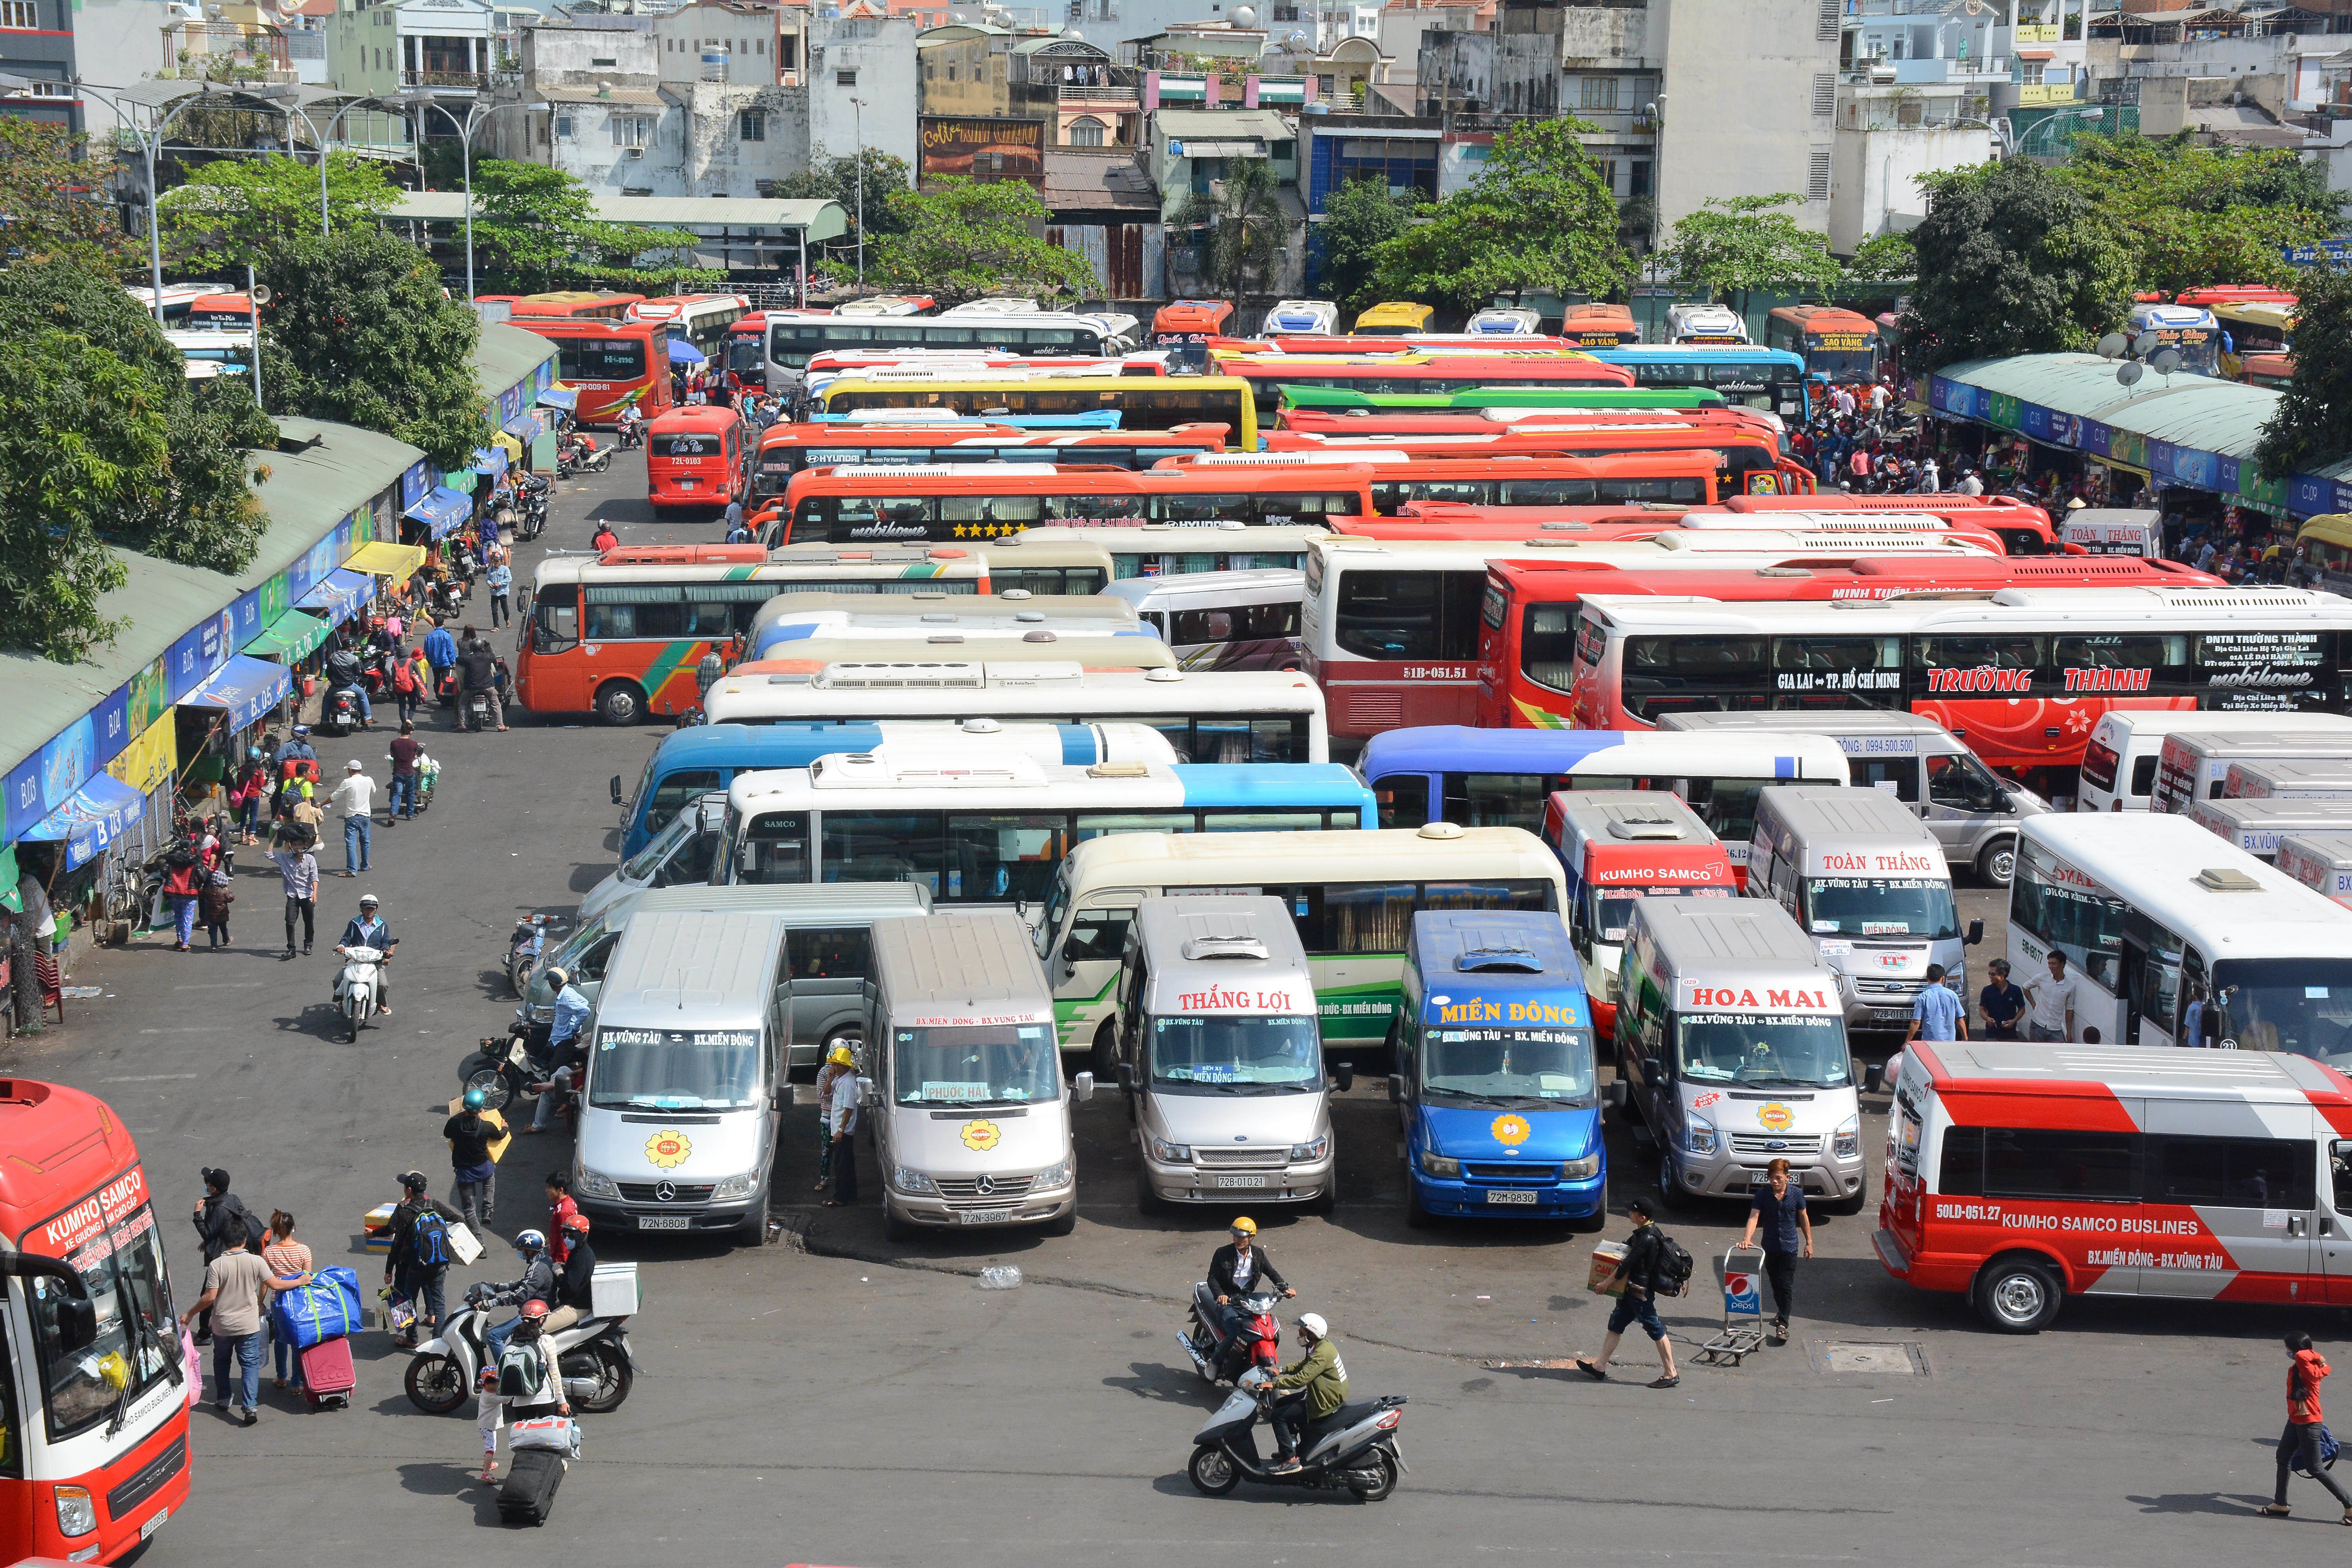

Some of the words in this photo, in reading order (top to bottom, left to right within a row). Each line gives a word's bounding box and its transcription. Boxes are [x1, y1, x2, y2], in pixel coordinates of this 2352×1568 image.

[924, 122, 960, 148] Coffee
[1158, 334, 1183, 345] Quốc
[1598, 337, 1619, 346] VÀNG
[1841, 337, 1862, 347] VÀNG
[1715, 381, 1766, 392] mobihome
[819, 455, 860, 463] HYUNDAI
[2223, 464, 2236, 481] C.10
[2302, 484, 2317, 501] C.09
[1116, 515, 1130, 528] MIỀN
[1266, 515, 1292, 523] New
[851, 521, 927, 538] mobihome
[2071, 526, 2097, 540] TOÀN
[2107, 525, 2141, 541] THẮNG
[2116, 545, 2127, 554] MIỀN
[1832, 588, 1870, 598] MINH
[245, 601, 255, 625] B.06
[2236, 632, 2279, 644] TRƯỜNG
[2281, 632, 2317, 643] THÀNH
[183, 648, 193, 674] B.05
[1778, 672, 1795, 690] GIA
[1797, 672, 1813, 690] LAI
[1827, 672, 1840, 689] TP.
[1842, 667, 1855, 689] HỒ
[1858, 668, 1874, 689] CHÍ
[1875, 672, 1900, 689] MINH
[1927, 665, 2034, 691] TRƯỜNG
[2064, 664, 2151, 691] THÀNH
[2209, 665, 2314, 686] mobihome
[251, 696, 260, 718] B.
[261, 686, 272, 710] 05
[108, 708, 121, 739] B.04
[1866, 739, 1913, 753] 0994.500.500
[21, 775, 36, 809] B.03
[109, 809, 122, 837] 03
[1823, 853, 1866, 869] TOÀN
[1876, 851, 1931, 870] THẮNG
[1600, 869, 1654, 881] KUMHO
[1658, 868, 1711, 880] SAMCO
[1649, 886, 1664, 895] HÀNG
[1815, 878, 1850, 888] BX.VŨNG
[1851, 878, 1868, 888] TÀU
[1889, 878, 1922, 889] BX.MIỀN
[1924, 878, 1946, 889] ĐÔNG
[1864, 923, 1884, 935] MIỀN
[1178, 984, 1250, 1011] THẮNG
[1257, 990, 1291, 1013] LỢI
[1691, 988, 1759, 1007] HOA
[1767, 989, 1828, 1008] MAI
[1353, 1001, 1370, 1014] MIỀN
[1372, 1002, 1392, 1014] ĐÔNG
[1440, 996, 1501, 1024] MIỀN
[1509, 1000, 1577, 1024] ĐÔNG
[916, 1015, 948, 1025] BX.MIỀN
[952, 1016, 974, 1025] ĐÔNG
[982, 1014, 1016, 1025] BX.VŨNG
[1018, 1013, 1035, 1022] TÀU
[1268, 1017, 1290, 1025] BX.MIỀN
[1691, 1014, 1734, 1025] BX.VŨNG
[1735, 1014, 1756, 1025] TÀU
[1766, 1015, 1804, 1026] BX.MIỀN
[1806, 1016, 1831, 1027] ĐÔNG
[602, 1031, 641, 1044] BX.VŨNG
[643, 1030, 662, 1045] TÀU
[694, 1031, 730, 1046] BX.MIỀN
[731, 1033, 755, 1047] ĐÔNG
[1442, 1031, 1457, 1043] BX.
[1459, 1030, 1482, 1042] VŨNG
[1483, 1029, 1501, 1041] TÀU
[1515, 1031, 1530, 1042] BX.
[1531, 1029, 1553, 1043] MIỀN
[1555, 1032, 1579, 1046] ĐÔNG
[1194, 1071, 1211, 1083] MIỀN
[1212, 1071, 1233, 1083] ĐÔNG
[929, 1085, 964, 1099] PHƯỚC
[1698, 1093, 1713, 1102] NEW
[1699, 1097, 1716, 1107] 2016
[1219, 1176, 1264, 1187] 72B-010.21
[1490, 1192, 1534, 1203] 72M-9830
[46, 1198, 100, 1245] KUMHO
[100, 1171, 141, 1211] SAMCO
[1936, 1205, 2001, 1220] 50LD-051.27
[64, 1240, 75, 1251] XE
[75, 1222, 101, 1244] GIƯỜNG
[114, 1203, 127, 1218] CAO
[126, 1196, 137, 1210] CẤP
[642, 1218, 687, 1229] 72N-6808
[964, 1212, 1007, 1223] 72N-3967
[2002, 1214, 2058, 1231] KUMHO
[2061, 1215, 2117, 1232] SAMCO
[2122, 1218, 2198, 1236] BUSLINES
[94, 1238, 113, 1264] ĐÔNG
[2087, 1247, 2125, 1266] BX.MIỀN
[2127, 1249, 2154, 1267] ĐÔNG
[2160, 1250, 2202, 1269] BX.VŨNG
[2203, 1253, 2223, 1270] TÀU
[1731, 1301, 1755, 1312] pepsi
[134, 1403, 151, 1422] SAMCO
[152, 1386, 172, 1409] BUSLINES
